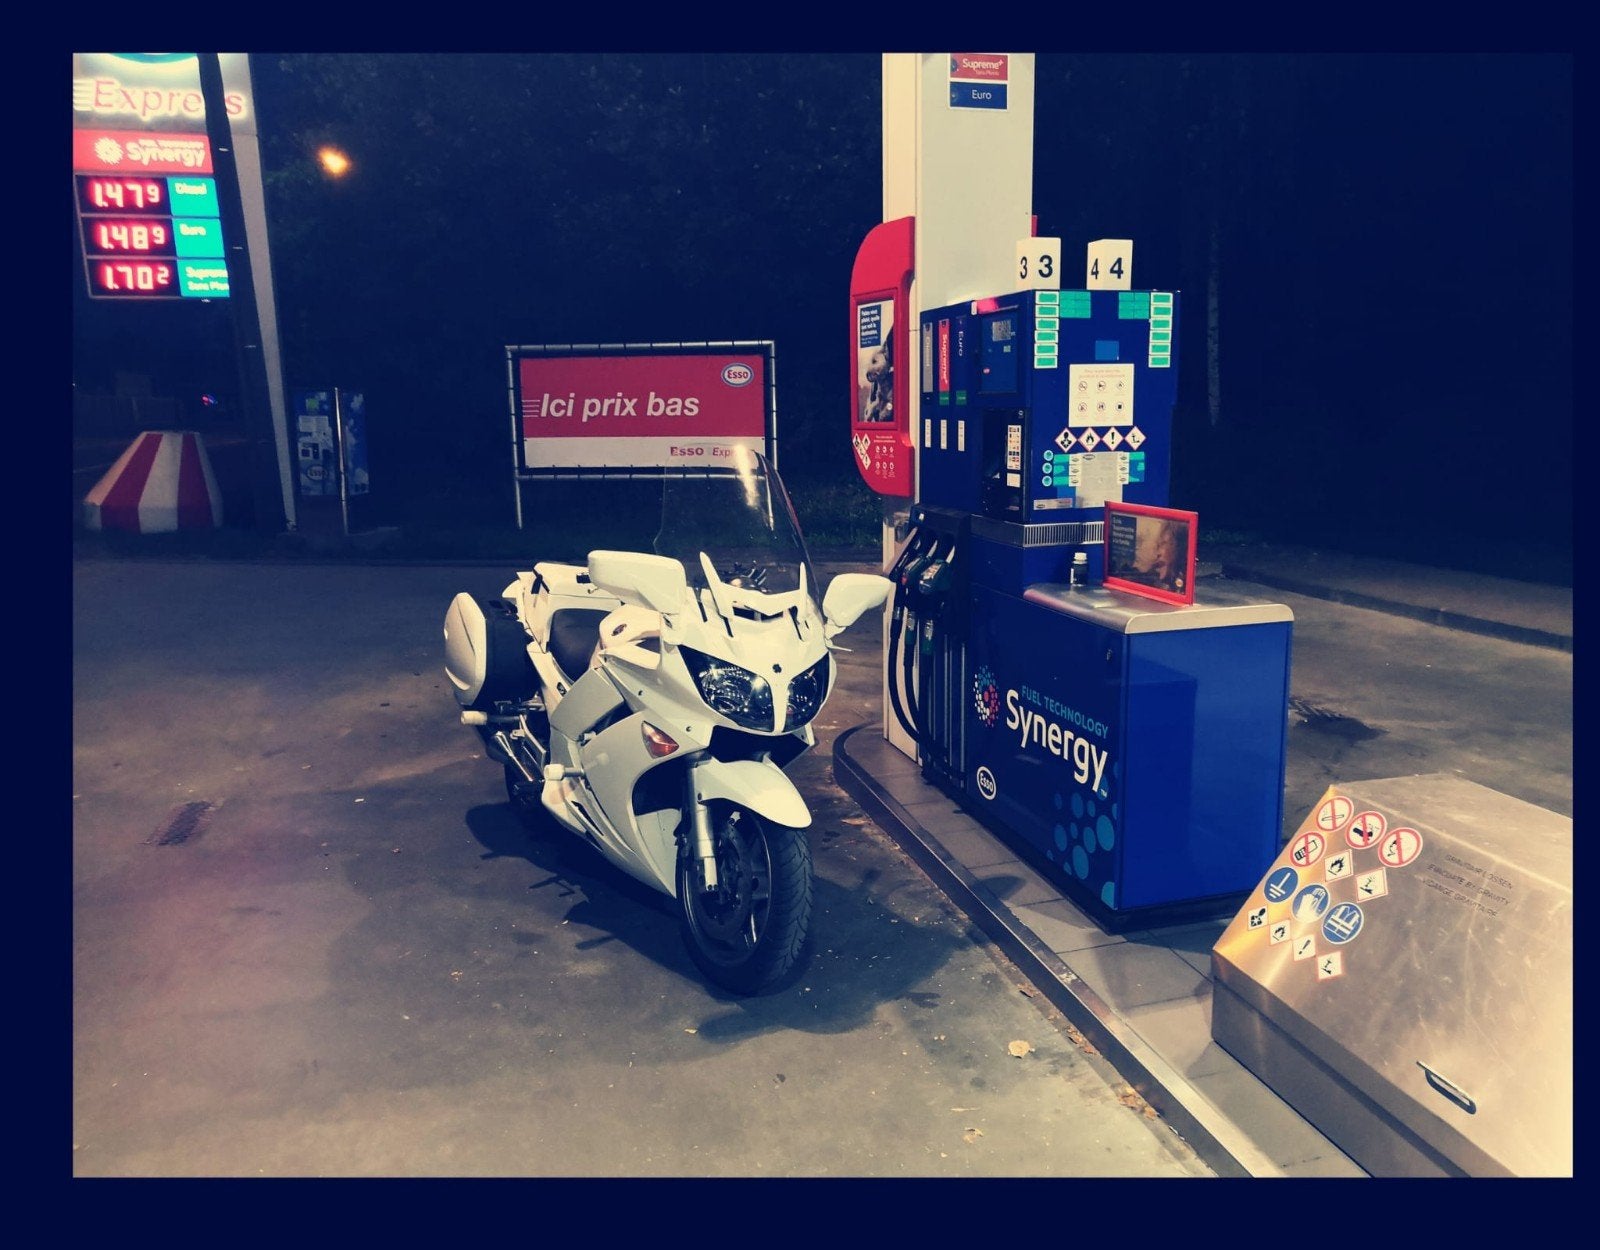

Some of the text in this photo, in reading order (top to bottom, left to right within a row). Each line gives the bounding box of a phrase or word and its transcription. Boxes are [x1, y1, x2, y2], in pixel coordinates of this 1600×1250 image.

[93, 79, 243, 117] Expres
[971, 90, 992, 100] Euro
[125, 142, 206, 167] Synergy
[1020, 256, 1028, 279] 3
[1038, 255, 1053, 278] 3
[1091, 258, 1099, 280] 4
[1109, 257, 1124, 280] 4
[727, 369, 749, 379] Esso
[540, 391, 700, 422] Ici prix bas
[669, 446, 704, 457] Esso
[1021, 685, 1109, 739] FUEL TECHNOLOGY
[1006, 689, 1108, 793] Synergy
[980, 772, 994, 792] Esso
